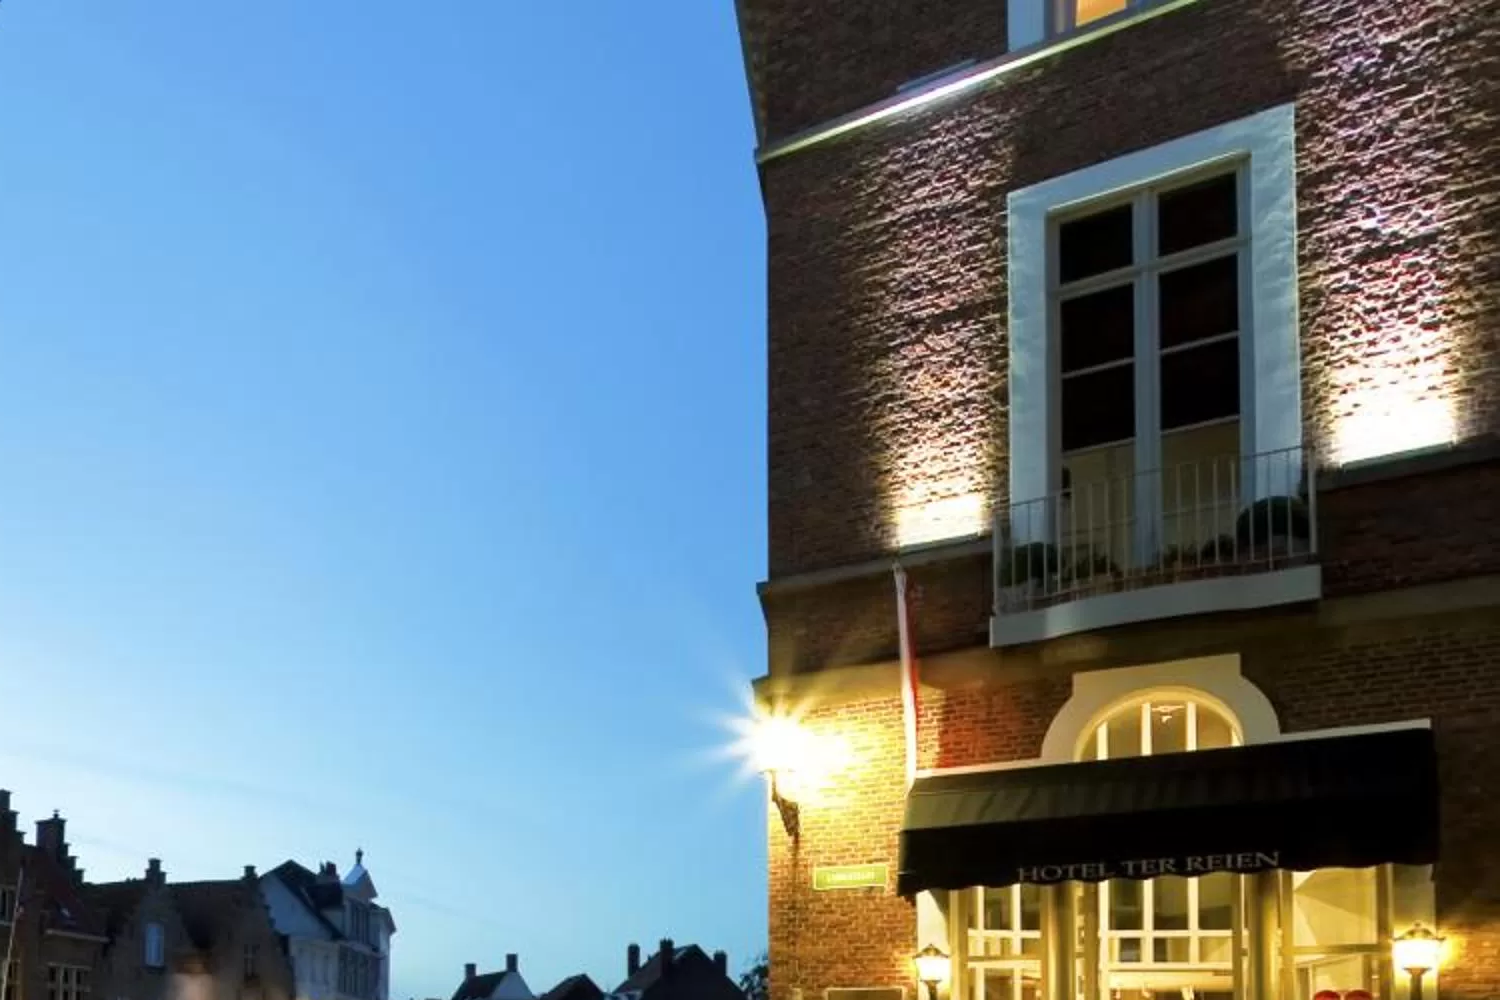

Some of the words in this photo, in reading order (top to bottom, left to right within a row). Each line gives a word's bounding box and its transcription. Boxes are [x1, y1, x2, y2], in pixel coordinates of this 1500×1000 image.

[1017, 863, 1115, 880] HOTEL
[1121, 858, 1176, 876] TER
[1186, 850, 1279, 871] REIEN
